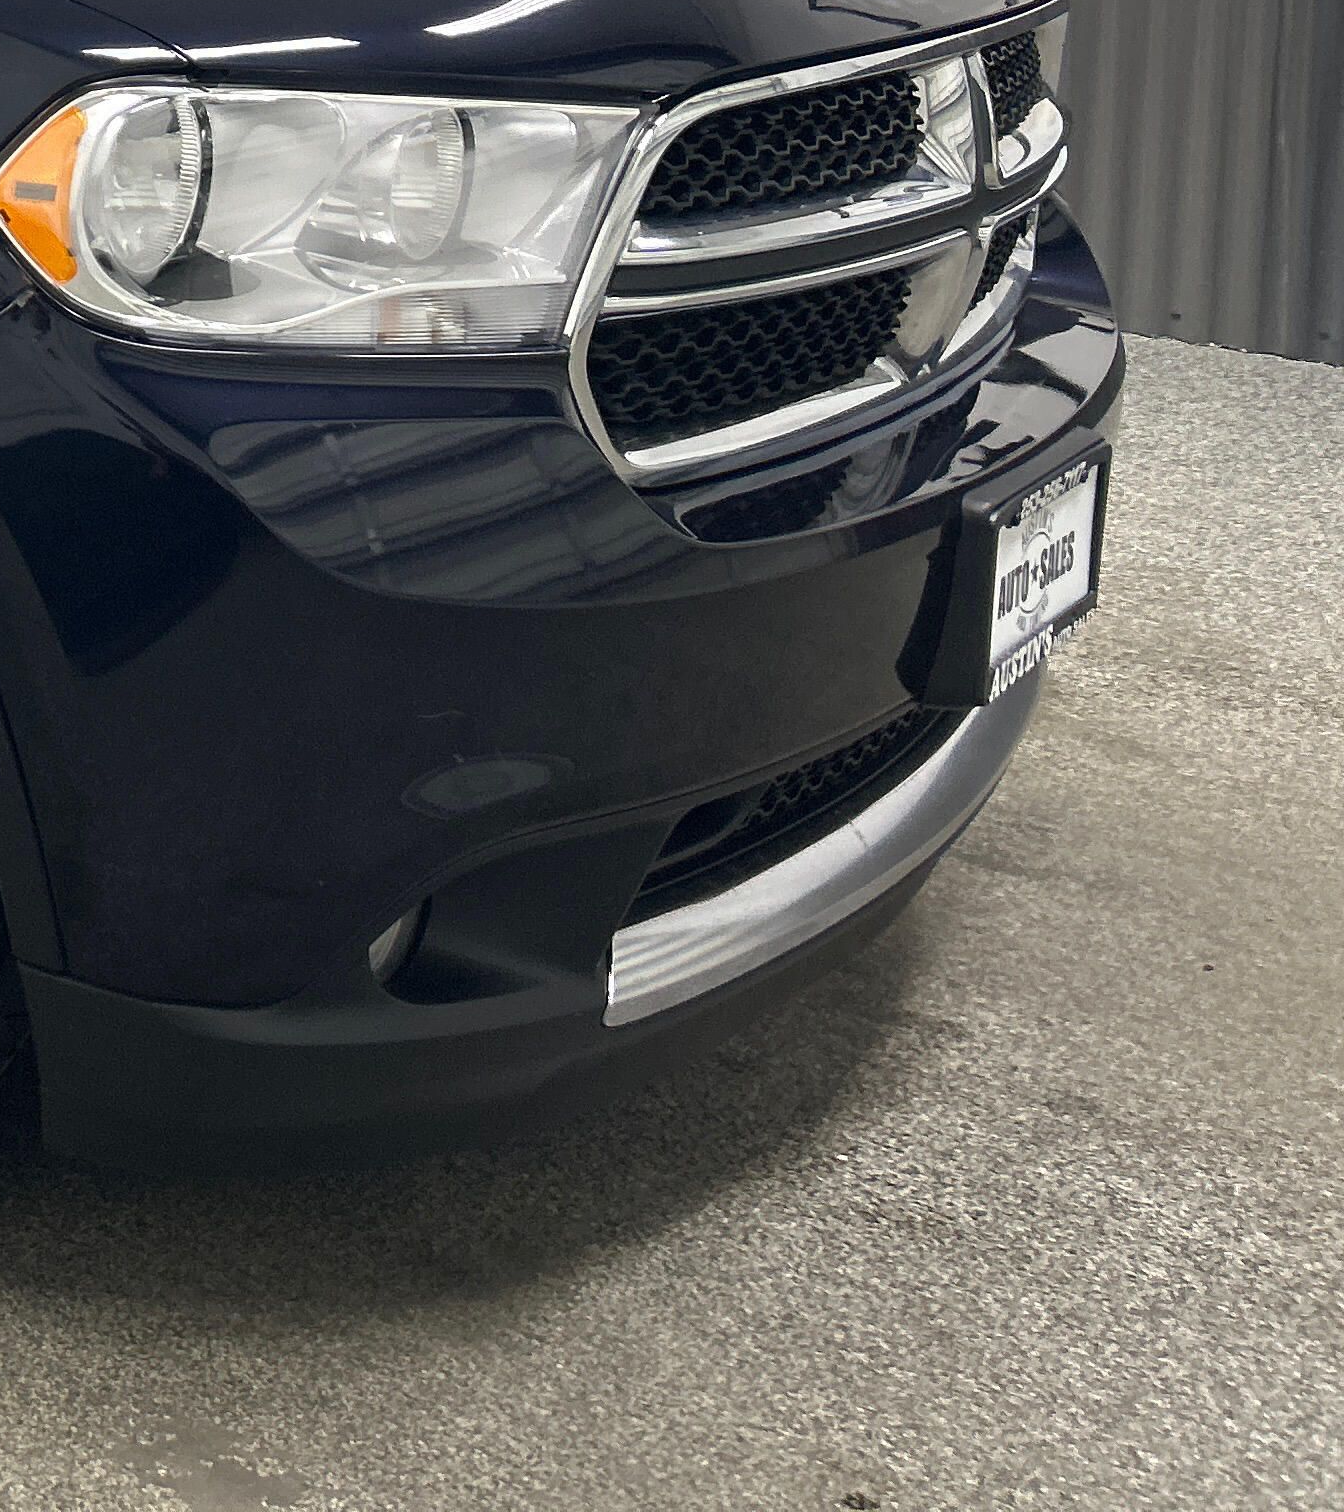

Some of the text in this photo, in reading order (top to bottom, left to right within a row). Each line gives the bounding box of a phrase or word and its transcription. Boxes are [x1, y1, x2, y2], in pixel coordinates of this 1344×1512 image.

[997, 559, 1030, 620] AUTO
[1040, 530, 1075, 589] SALES
[989, 623, 1054, 703] AUSTIN'S
